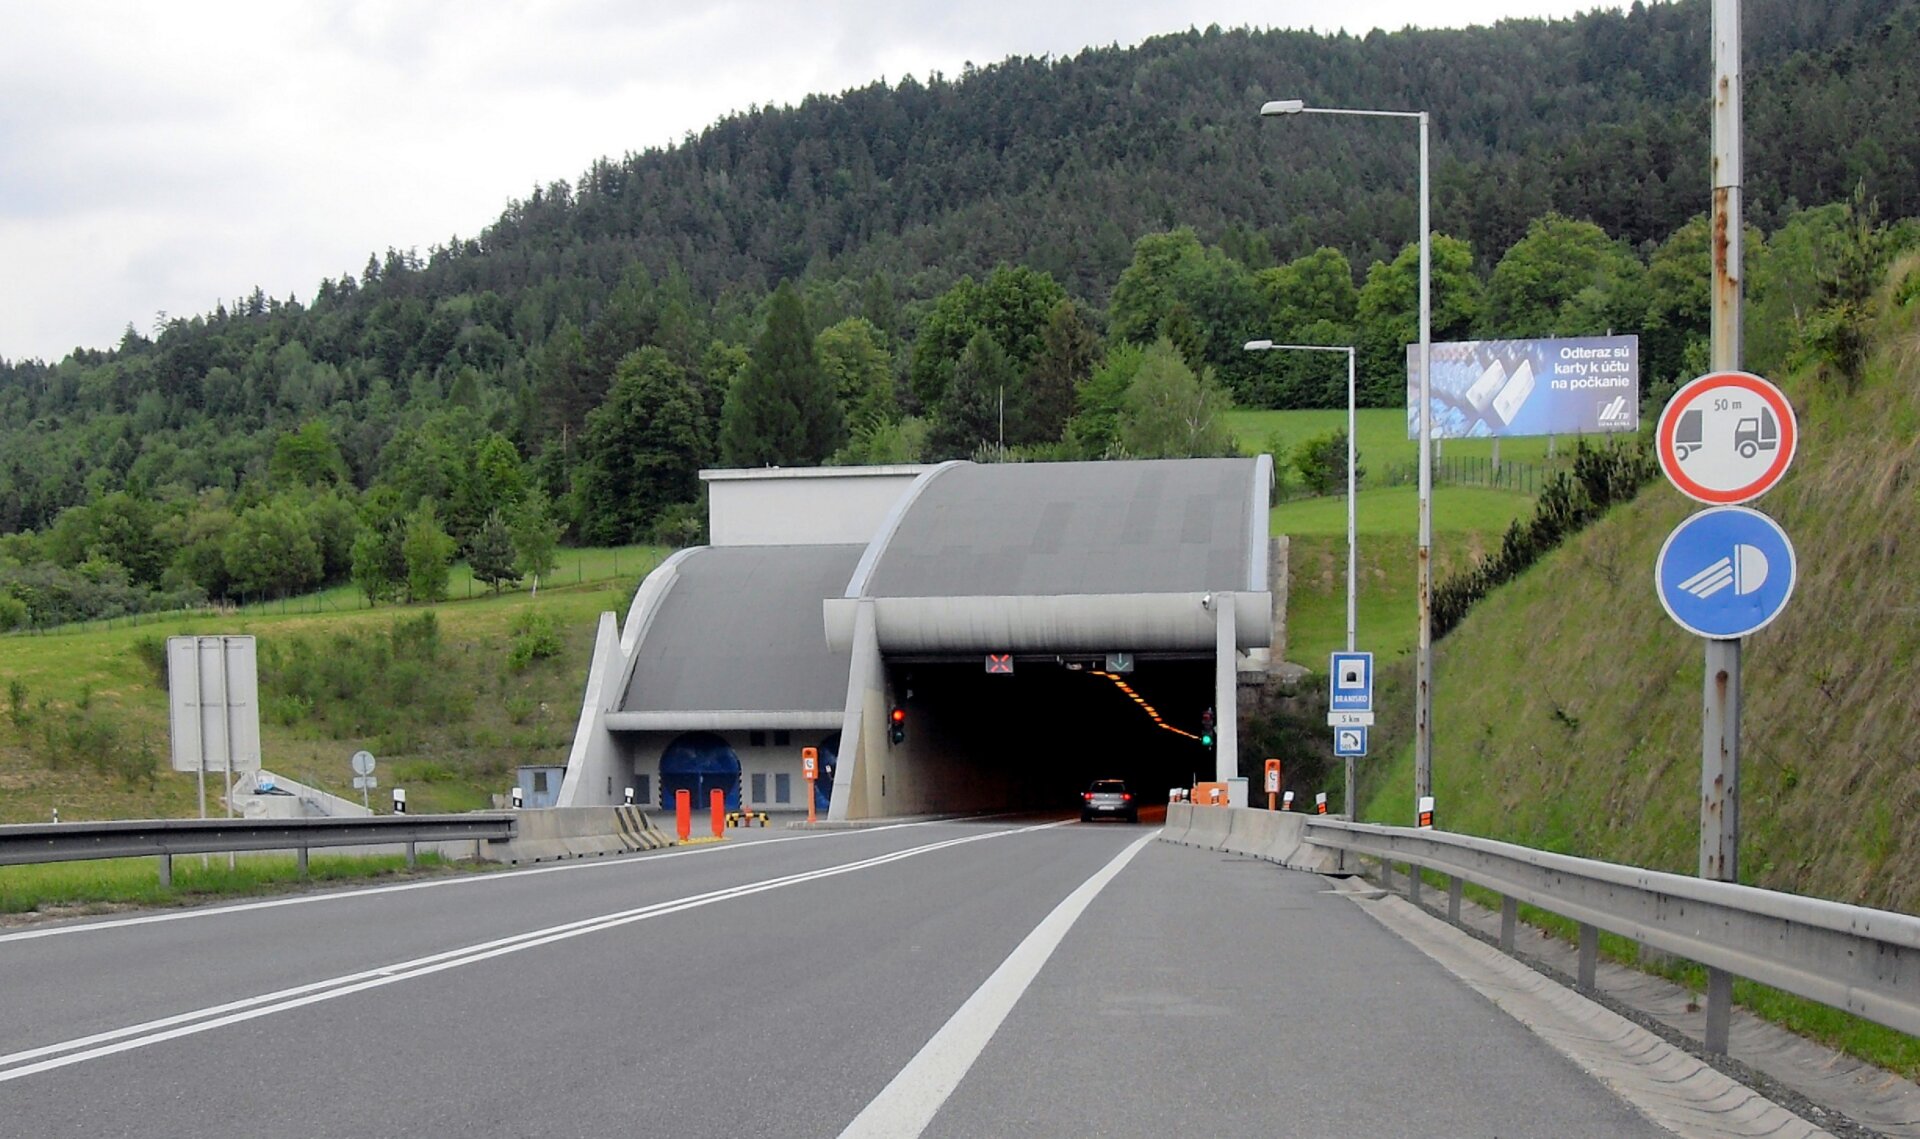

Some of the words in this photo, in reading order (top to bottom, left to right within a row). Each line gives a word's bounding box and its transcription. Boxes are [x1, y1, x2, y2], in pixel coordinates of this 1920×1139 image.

[1560, 347, 1611, 359] Odteraz
[1614, 345, 1629, 357] sú
[1554, 362, 1588, 375] karty
[1590, 361, 1599, 373] k
[1601, 360, 1629, 372] účtu
[1551, 379, 1568, 389] na
[1570, 375, 1630, 391] počkanie
[1714, 398, 1729, 411] 50
[1732, 401, 1742, 410] m
[1335, 695, 1368, 703] BRANISKO
[1342, 714, 1346, 723] 5
[1349, 714, 1360, 723] km
